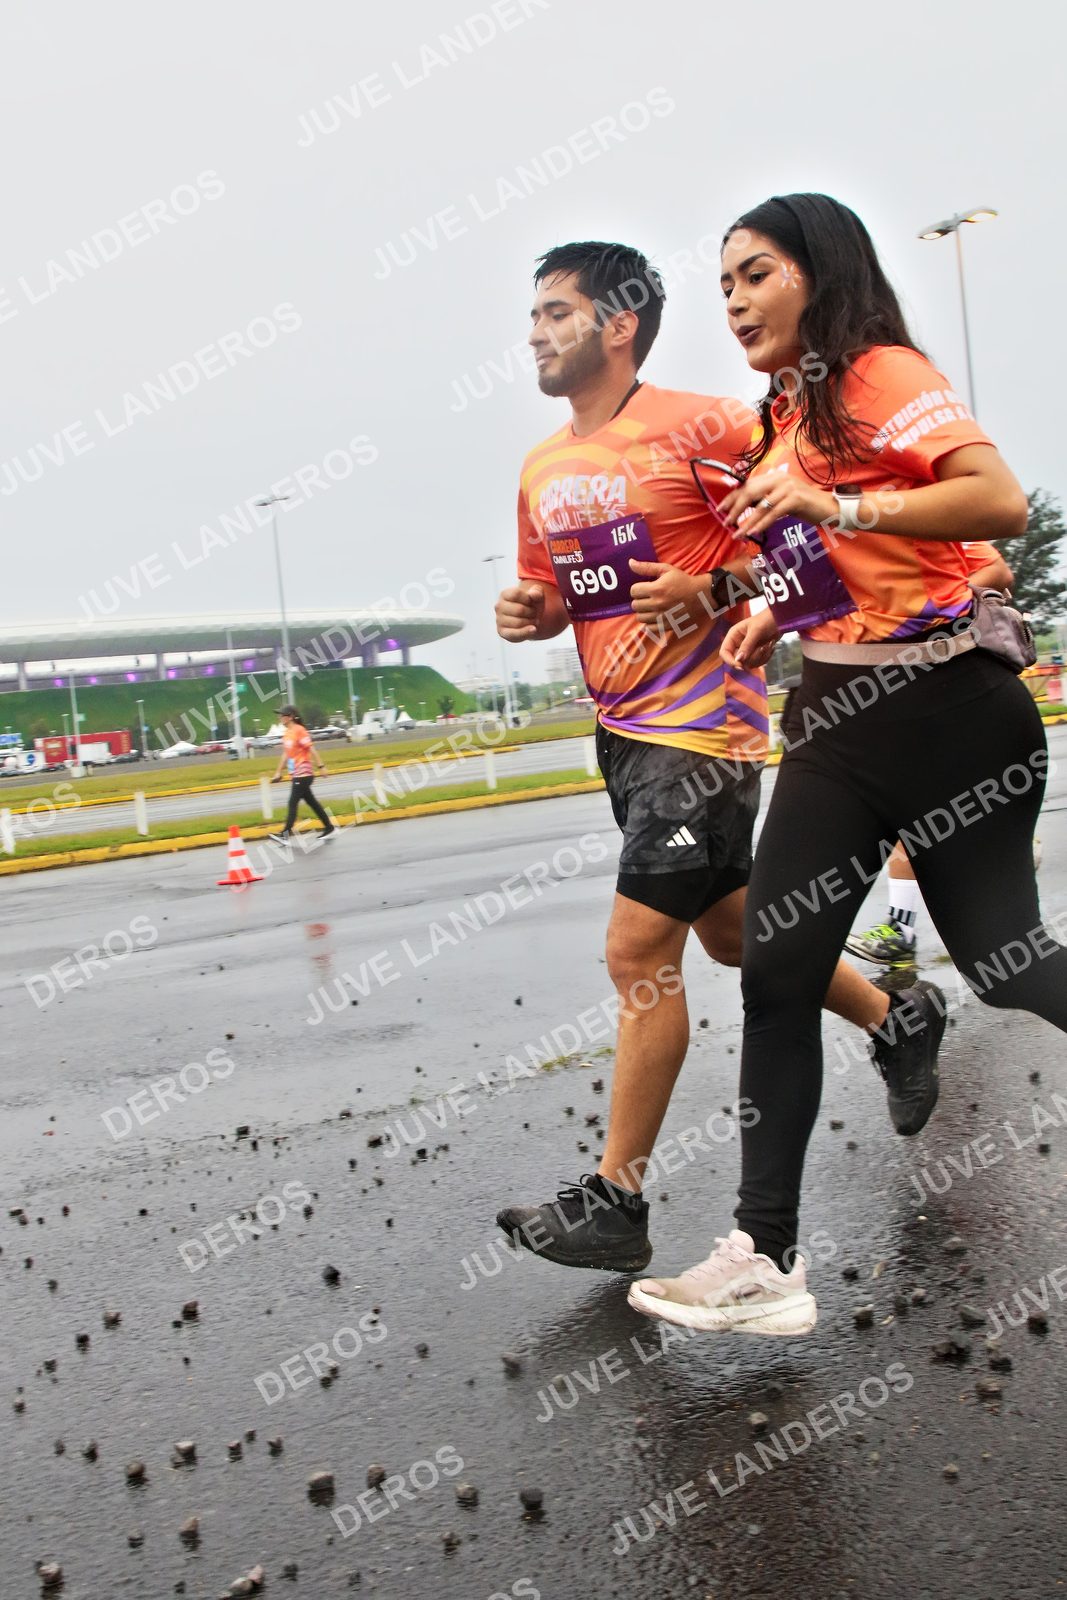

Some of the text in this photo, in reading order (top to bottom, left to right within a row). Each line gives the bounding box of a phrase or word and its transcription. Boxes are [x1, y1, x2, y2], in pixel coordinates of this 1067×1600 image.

[891, 407, 957, 453] IMPULSA
[611, 522, 637, 546] 15K
[782, 523, 807, 549] 15K
[570, 565, 618, 595] 690
[761, 568, 804, 605] 691
